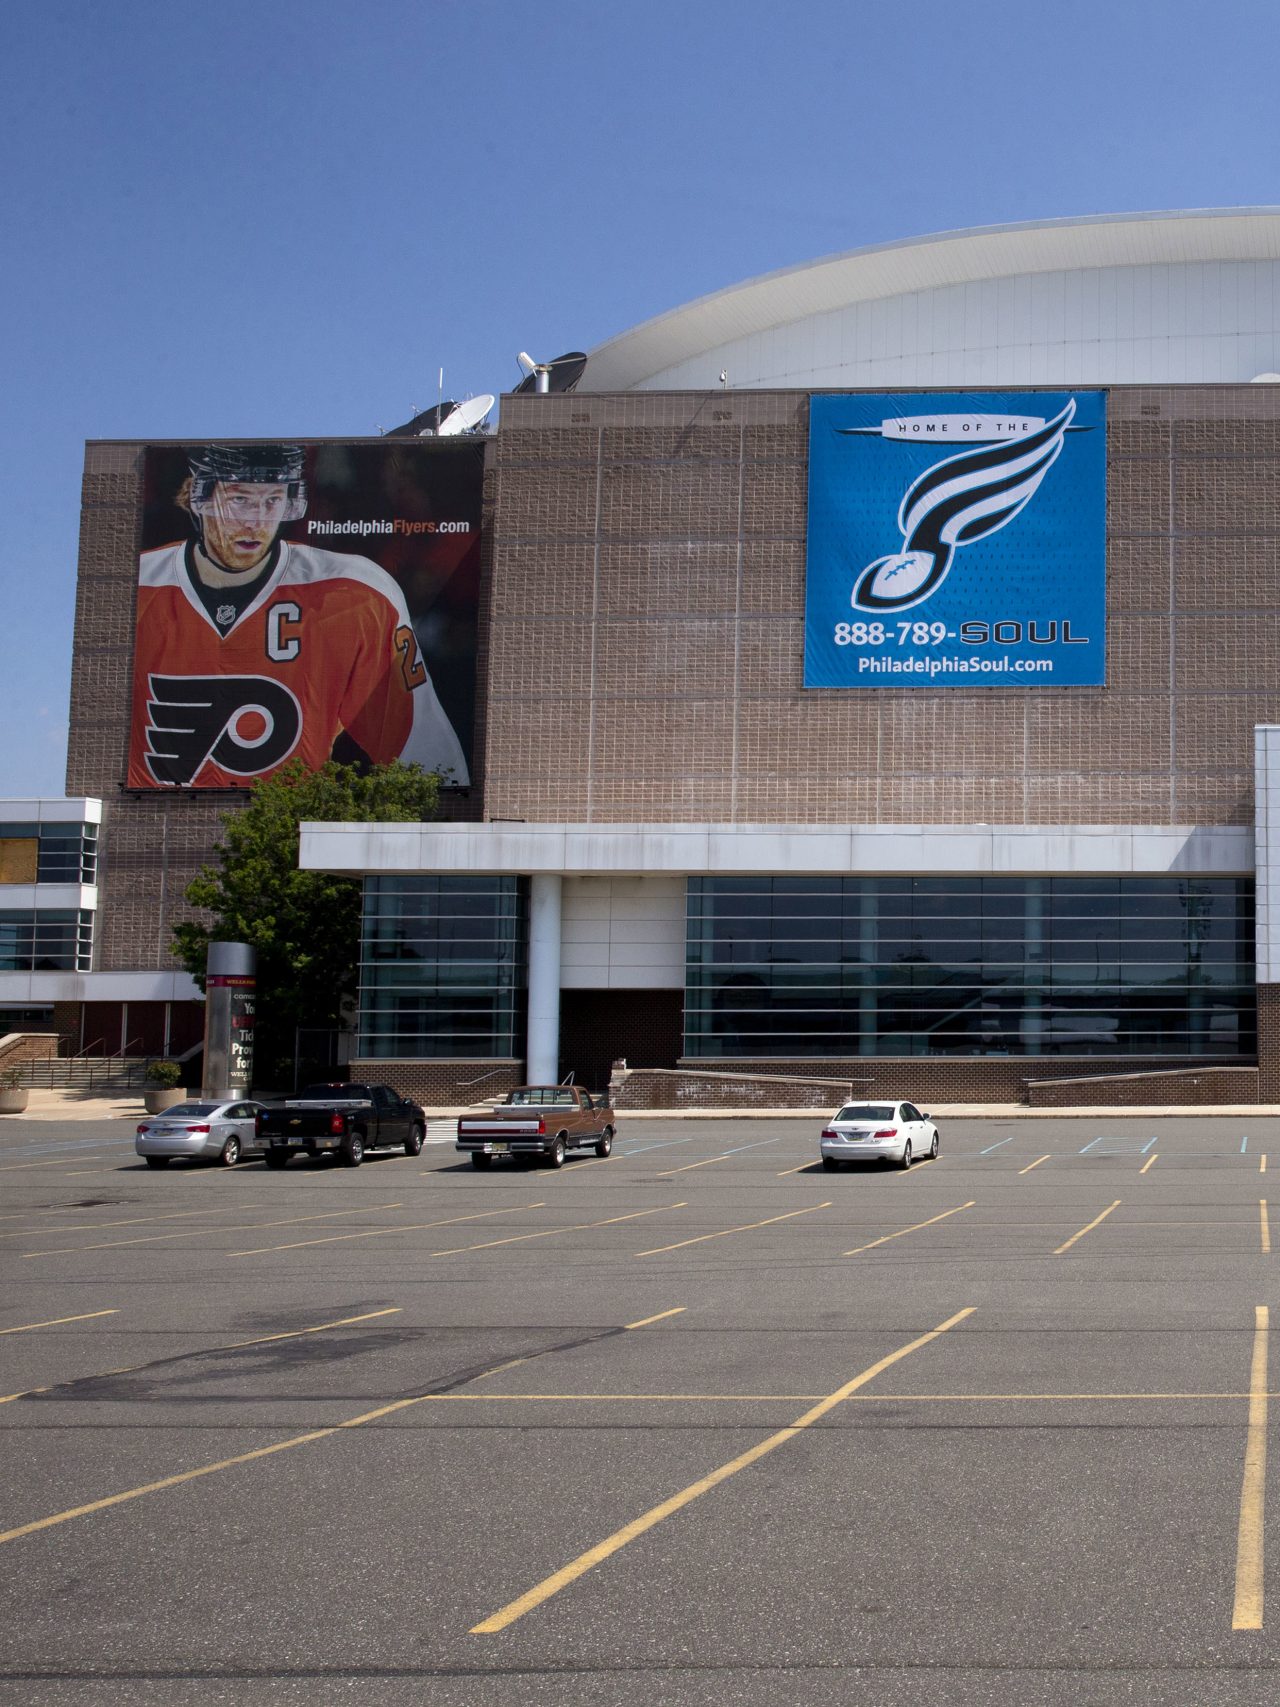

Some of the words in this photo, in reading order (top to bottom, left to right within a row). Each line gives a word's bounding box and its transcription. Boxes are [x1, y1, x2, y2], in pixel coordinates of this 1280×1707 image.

[898, 423, 948, 433] HOME
[962, 423, 982, 432] OF
[996, 422, 1029, 432] THE
[307, 519, 470, 537] PhiladelphiaFlyers.com
[265, 601, 302, 664] C
[834, 620, 1090, 646] 888-789-SOUL
[858, 656, 1053, 677] PhiladelphiaSoul.com
